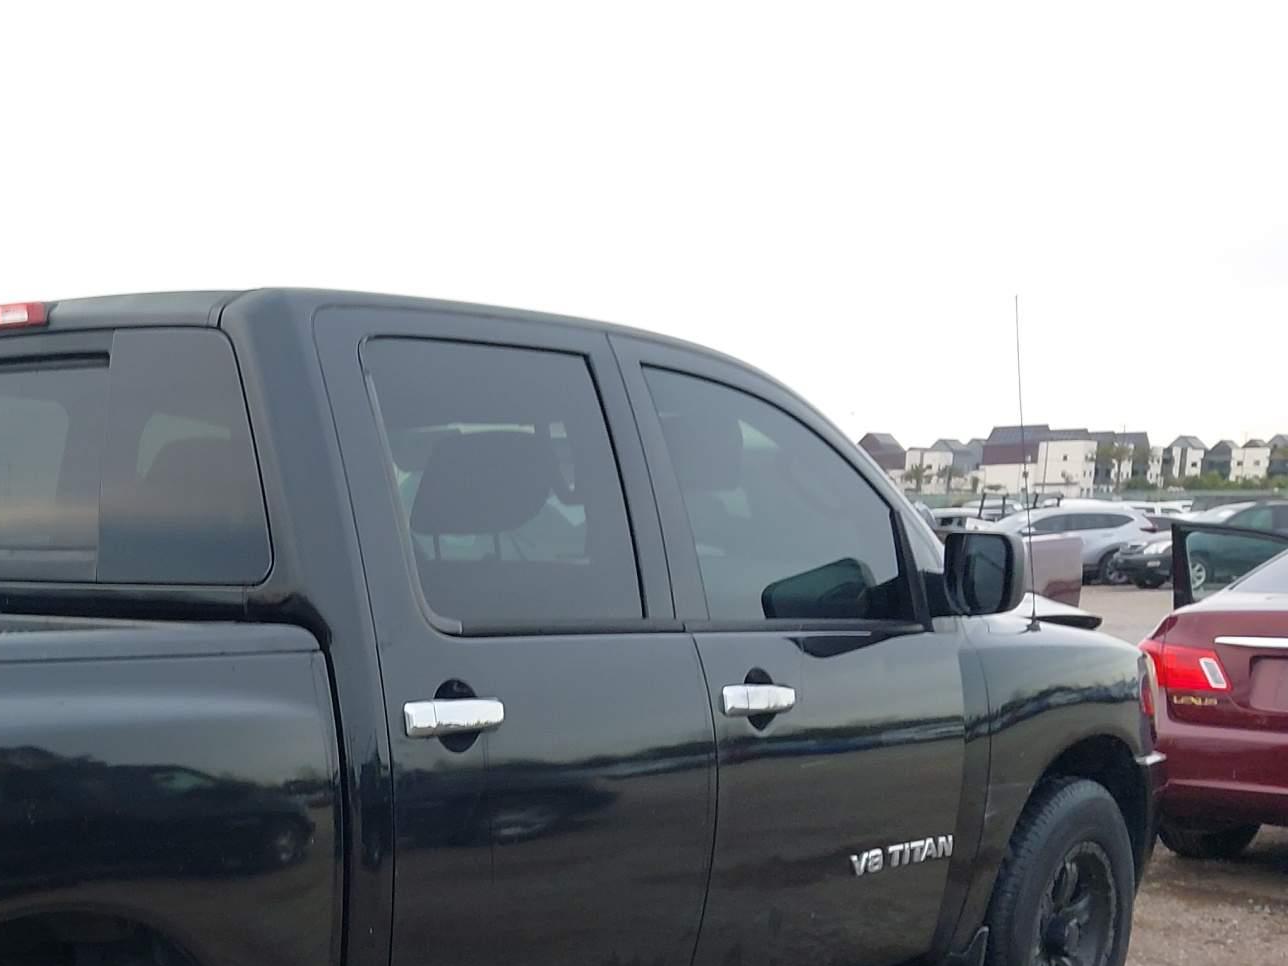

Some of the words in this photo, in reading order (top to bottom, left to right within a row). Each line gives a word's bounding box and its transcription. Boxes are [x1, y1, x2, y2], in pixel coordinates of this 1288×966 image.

[1173, 695, 1218, 706] LEXUS
[850, 848, 884, 876] V8
[888, 834, 953, 867] TITAN
